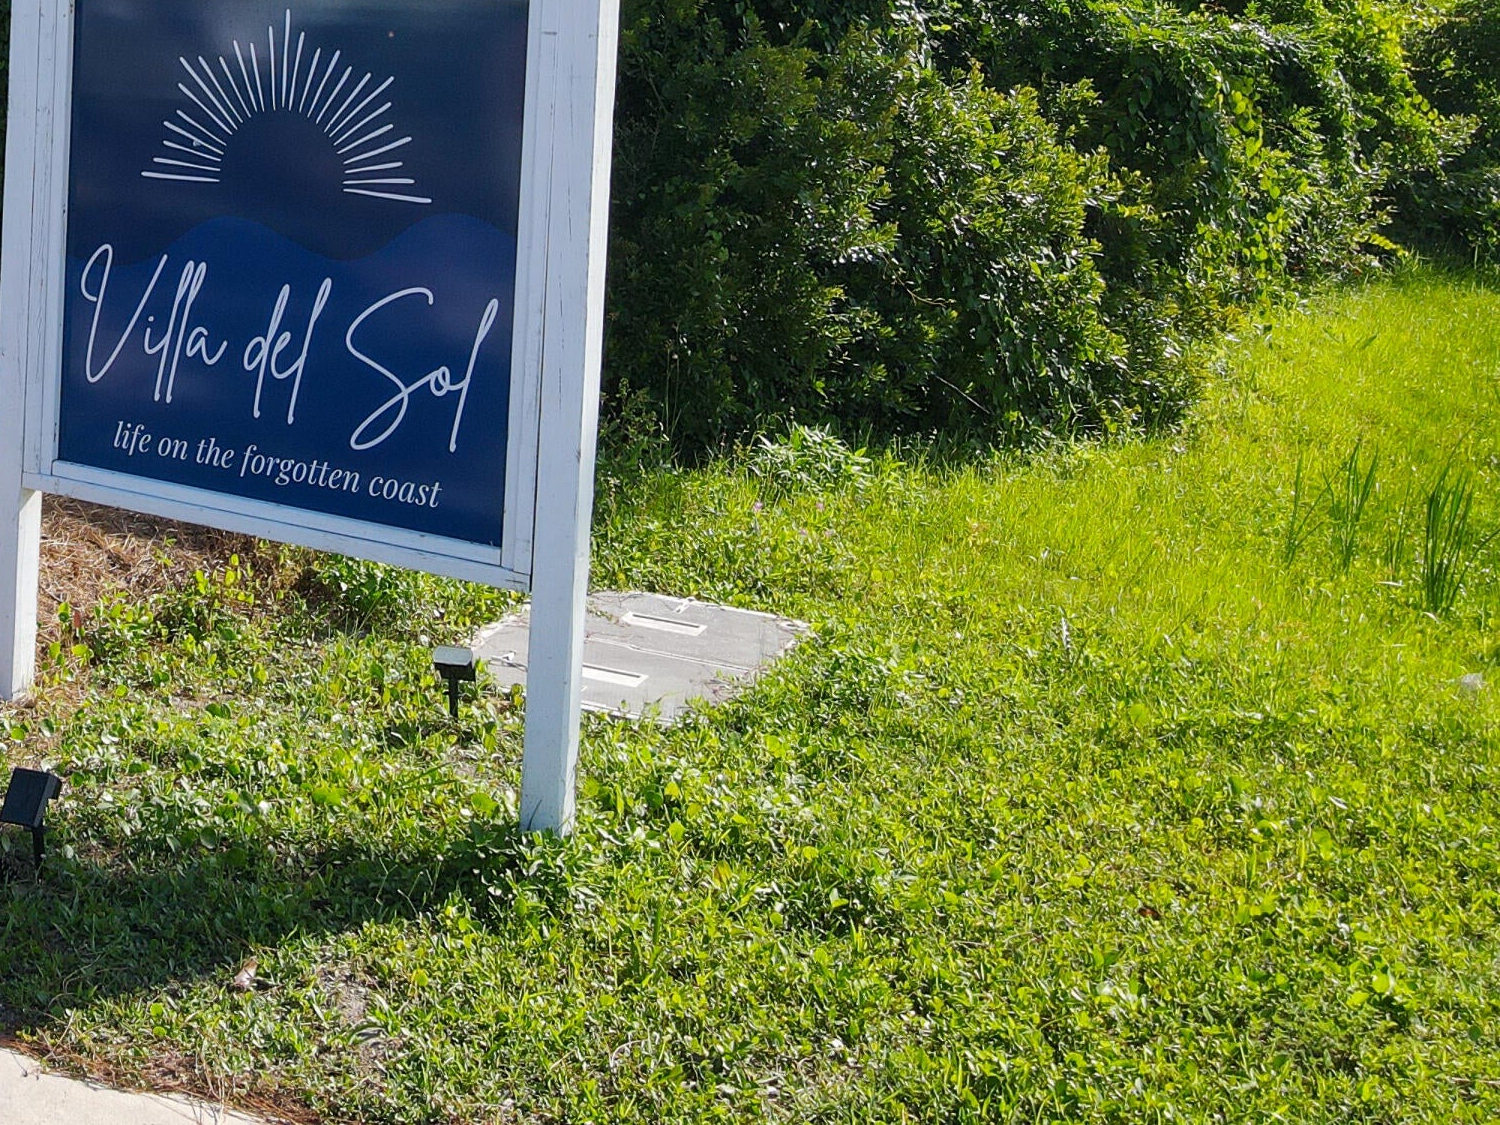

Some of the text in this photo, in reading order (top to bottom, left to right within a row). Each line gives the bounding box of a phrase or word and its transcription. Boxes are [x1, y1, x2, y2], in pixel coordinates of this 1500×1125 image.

[81, 244, 498, 452] Villa del Sol
[114, 421, 442, 507] life on the forgotten coast
